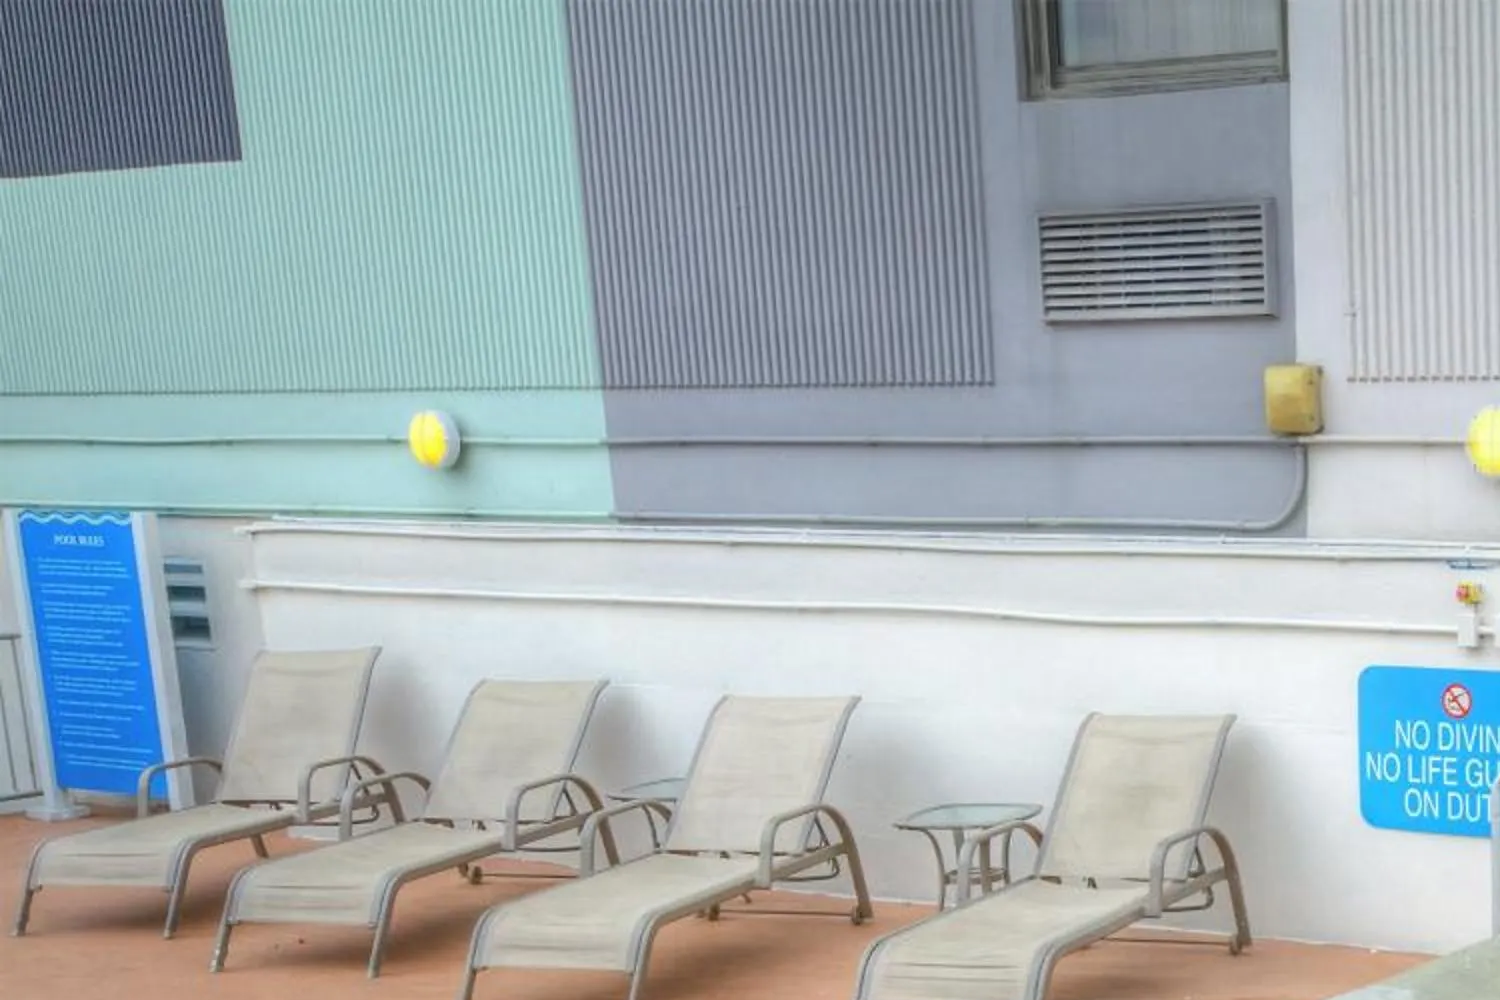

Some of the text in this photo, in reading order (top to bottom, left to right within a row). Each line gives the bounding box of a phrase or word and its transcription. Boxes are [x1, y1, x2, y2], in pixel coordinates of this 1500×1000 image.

[1394, 720, 1431, 751] NO
[1365, 752, 1400, 783] NO
[1407, 755, 1459, 786] LIFE
[1404, 788, 1439, 820] ON
